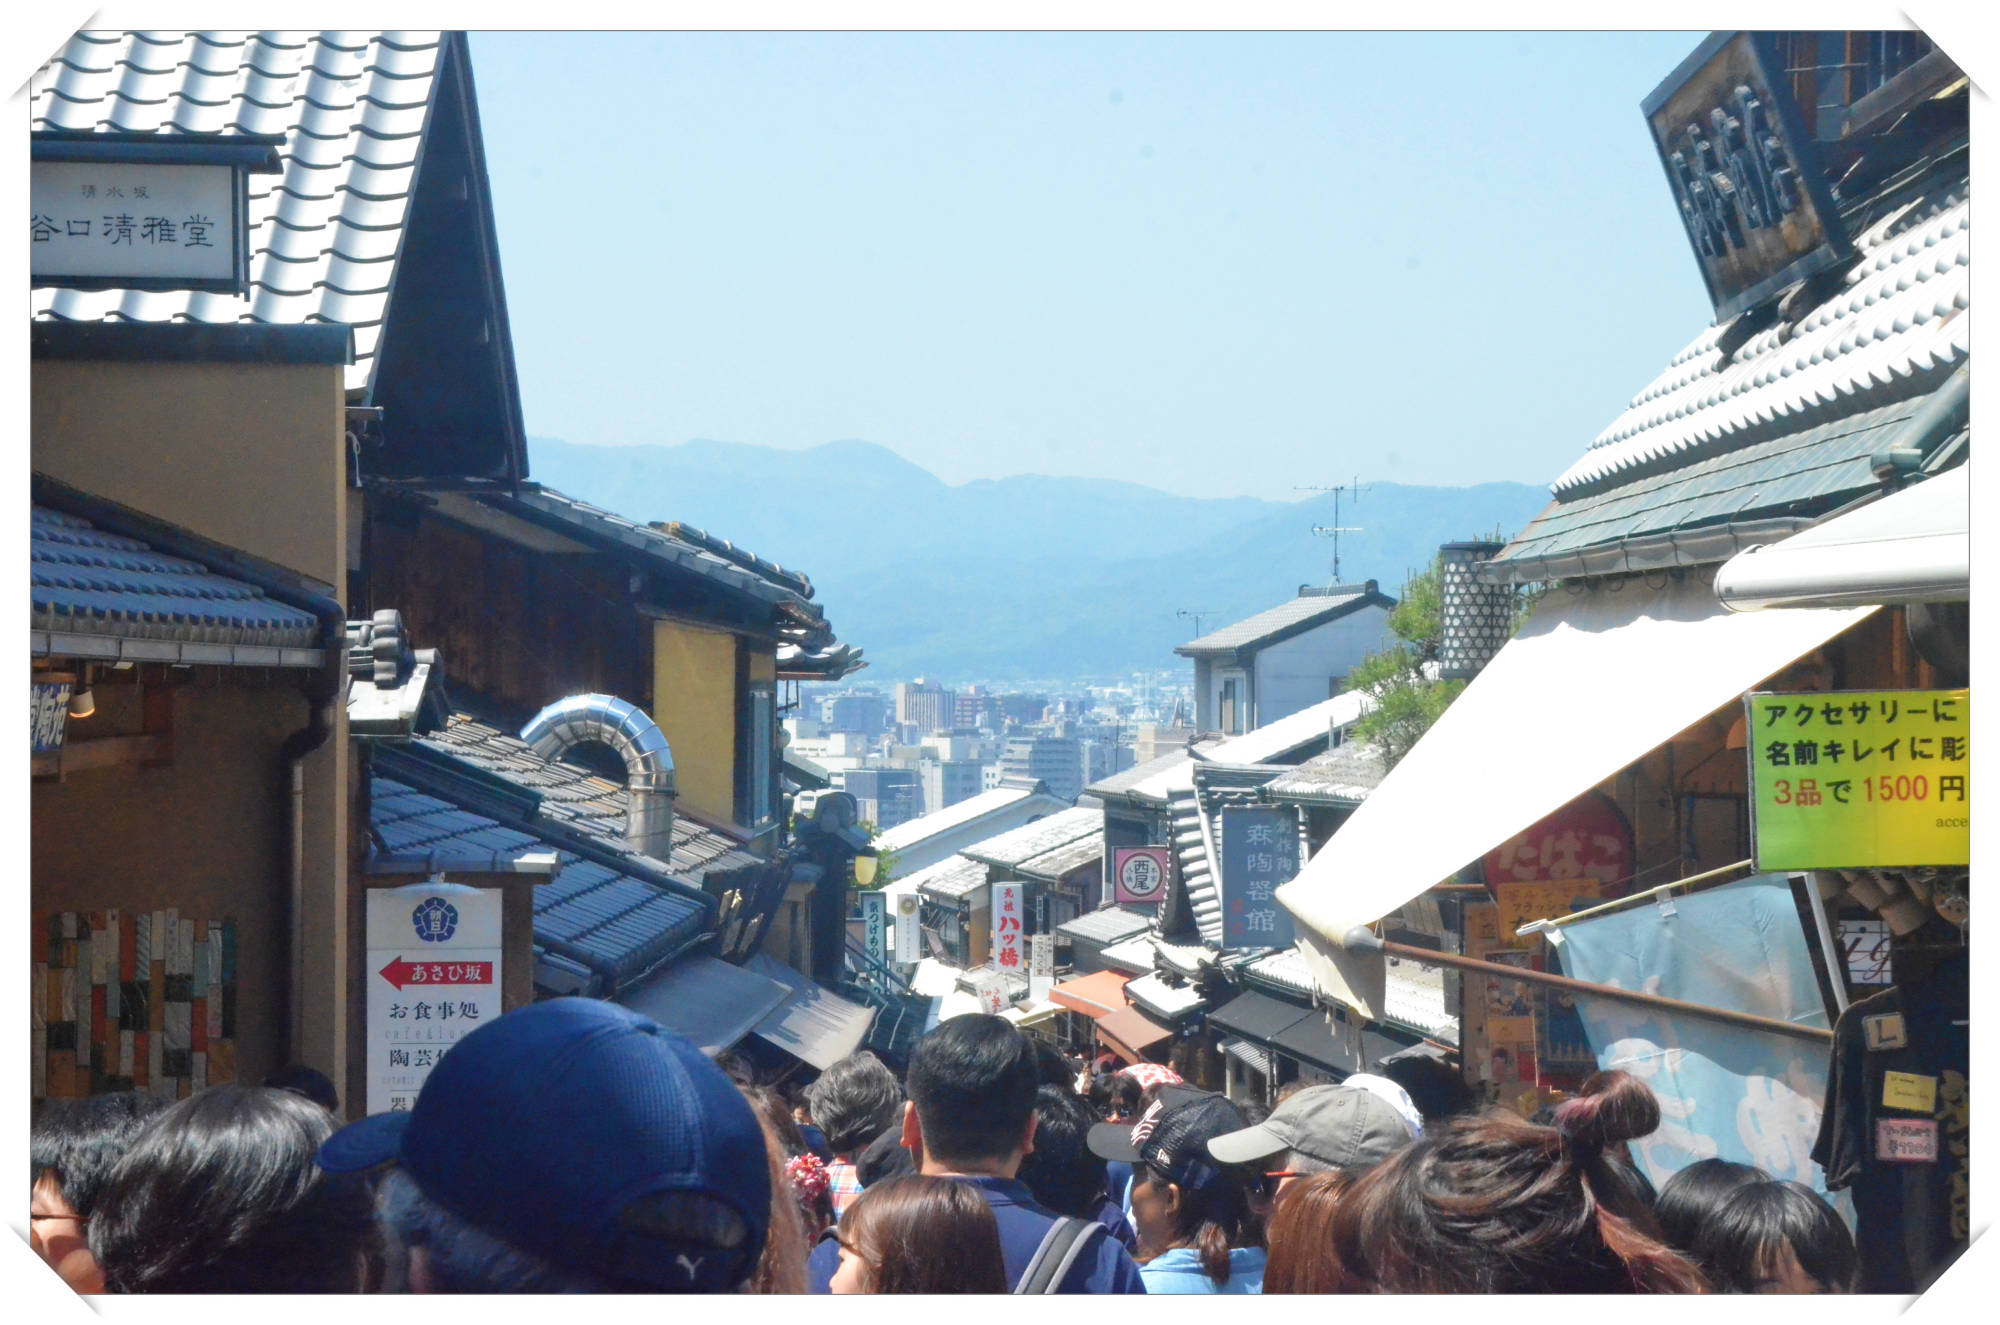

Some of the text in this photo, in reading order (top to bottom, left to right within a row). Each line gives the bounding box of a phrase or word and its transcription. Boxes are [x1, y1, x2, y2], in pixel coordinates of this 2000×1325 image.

[31, 213, 214, 247] 谷口清雅堂
[1764, 698, 1957, 728] アクセサリーに
[1765, 736, 1966, 766] 名前キレイに彫
[1276, 817, 1294, 881] 創作陶
[1497, 831, 1623, 881] たばこ
[1132, 860, 1150, 889] 西尾
[411, 964, 482, 982] あさひ坂
[389, 1001, 479, 1020] お食事処
[1875, 1019, 1897, 1043] L
[390, 1049, 448, 1067] 陶芸
